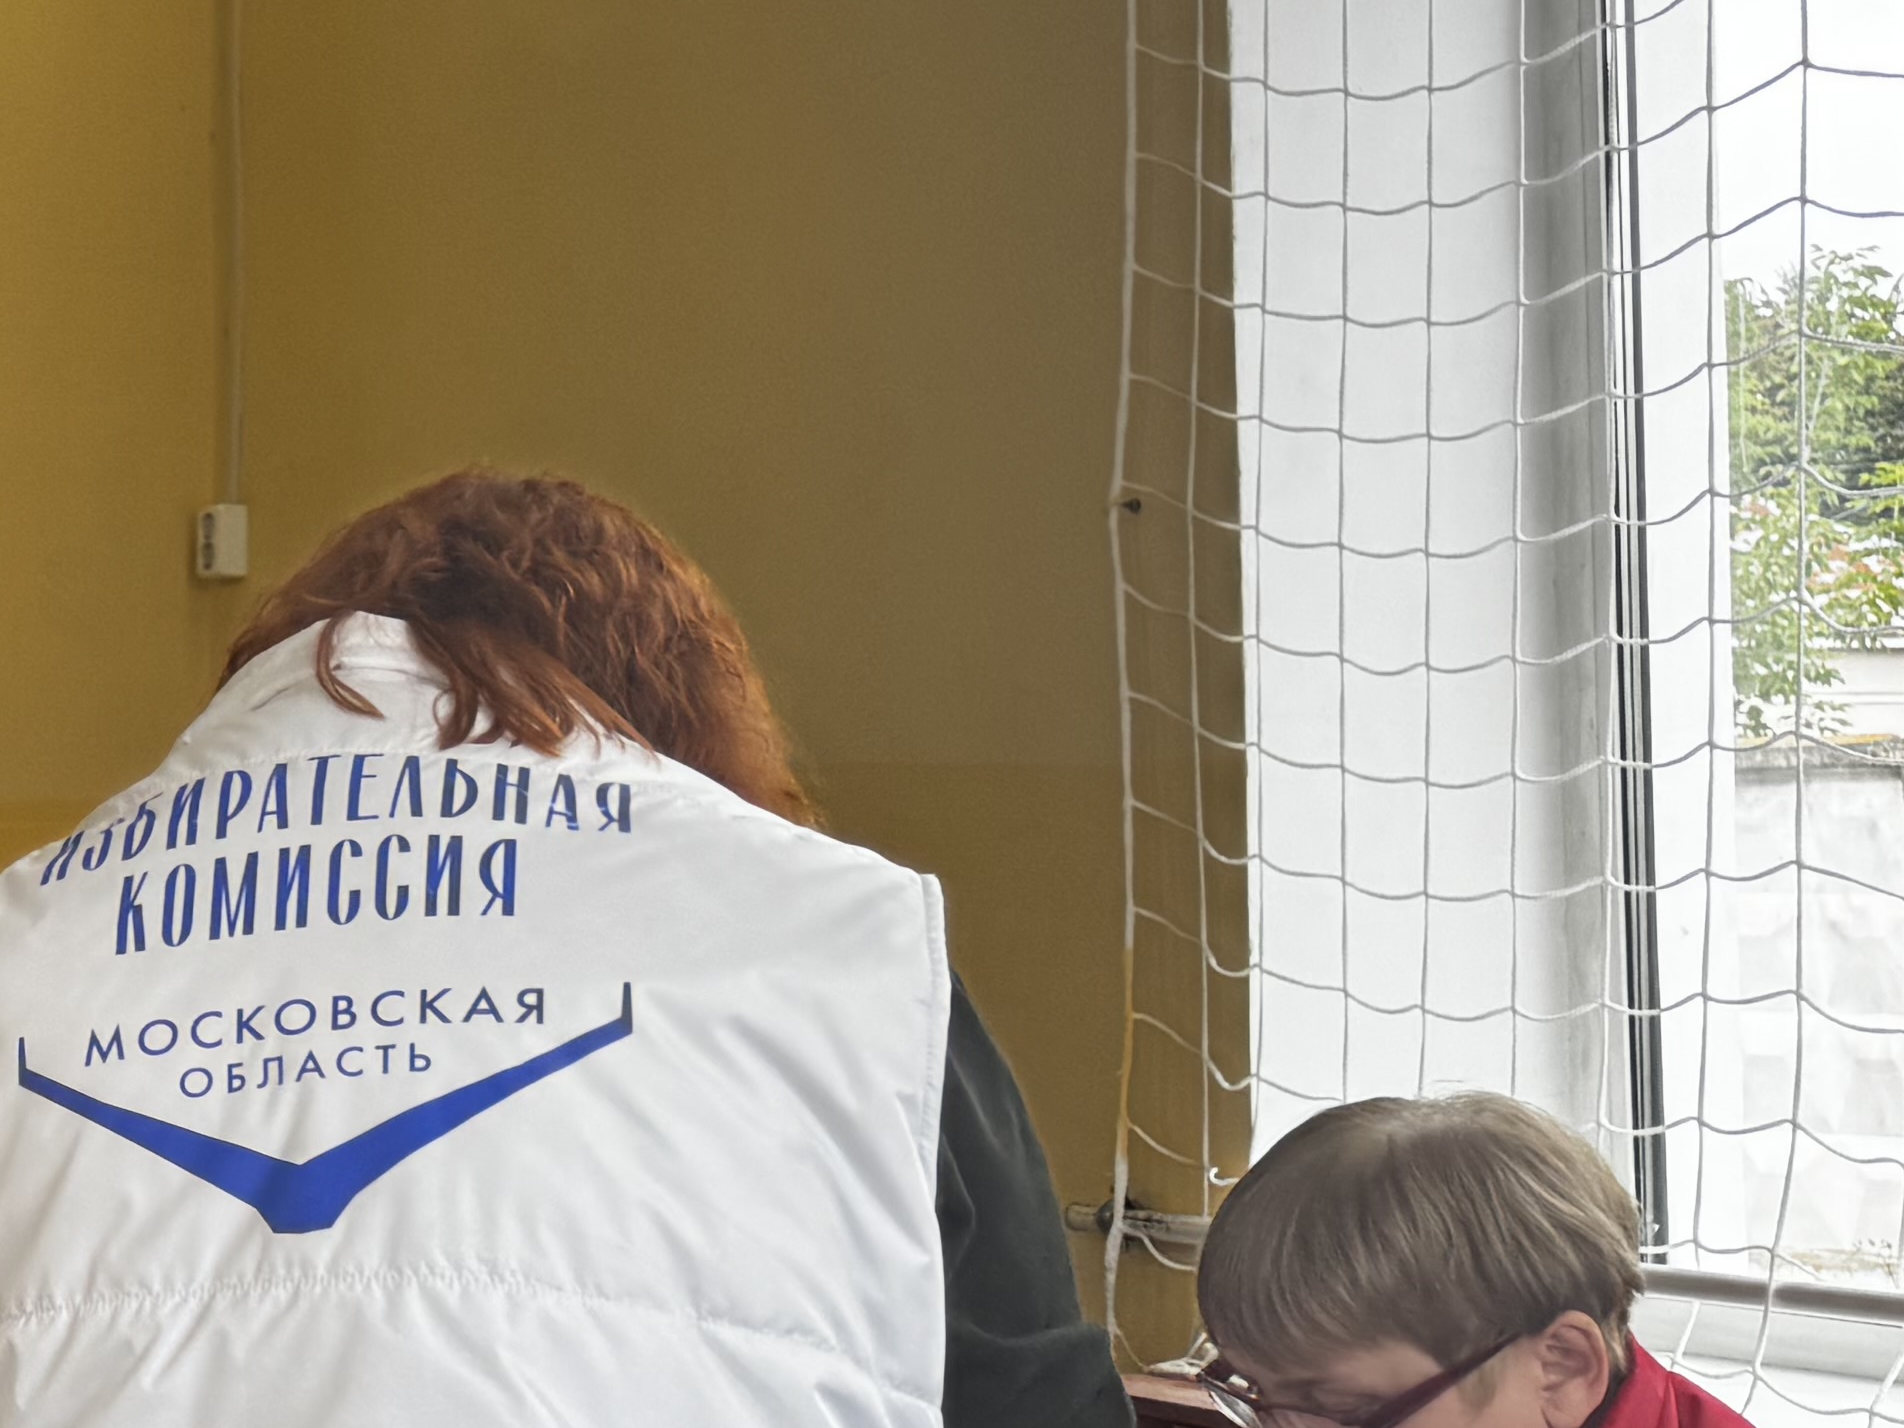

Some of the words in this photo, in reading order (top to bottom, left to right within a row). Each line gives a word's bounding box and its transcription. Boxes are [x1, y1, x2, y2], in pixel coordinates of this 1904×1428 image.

[40, 753, 633, 886] ИЗБИРАТЕЛЬНАЯ
[114, 833, 518, 956] КОМИССИЯ
[84, 985, 545, 1067] МОСКОВСКАЯ
[178, 1042, 433, 1099] ОБЛАСТЬ
